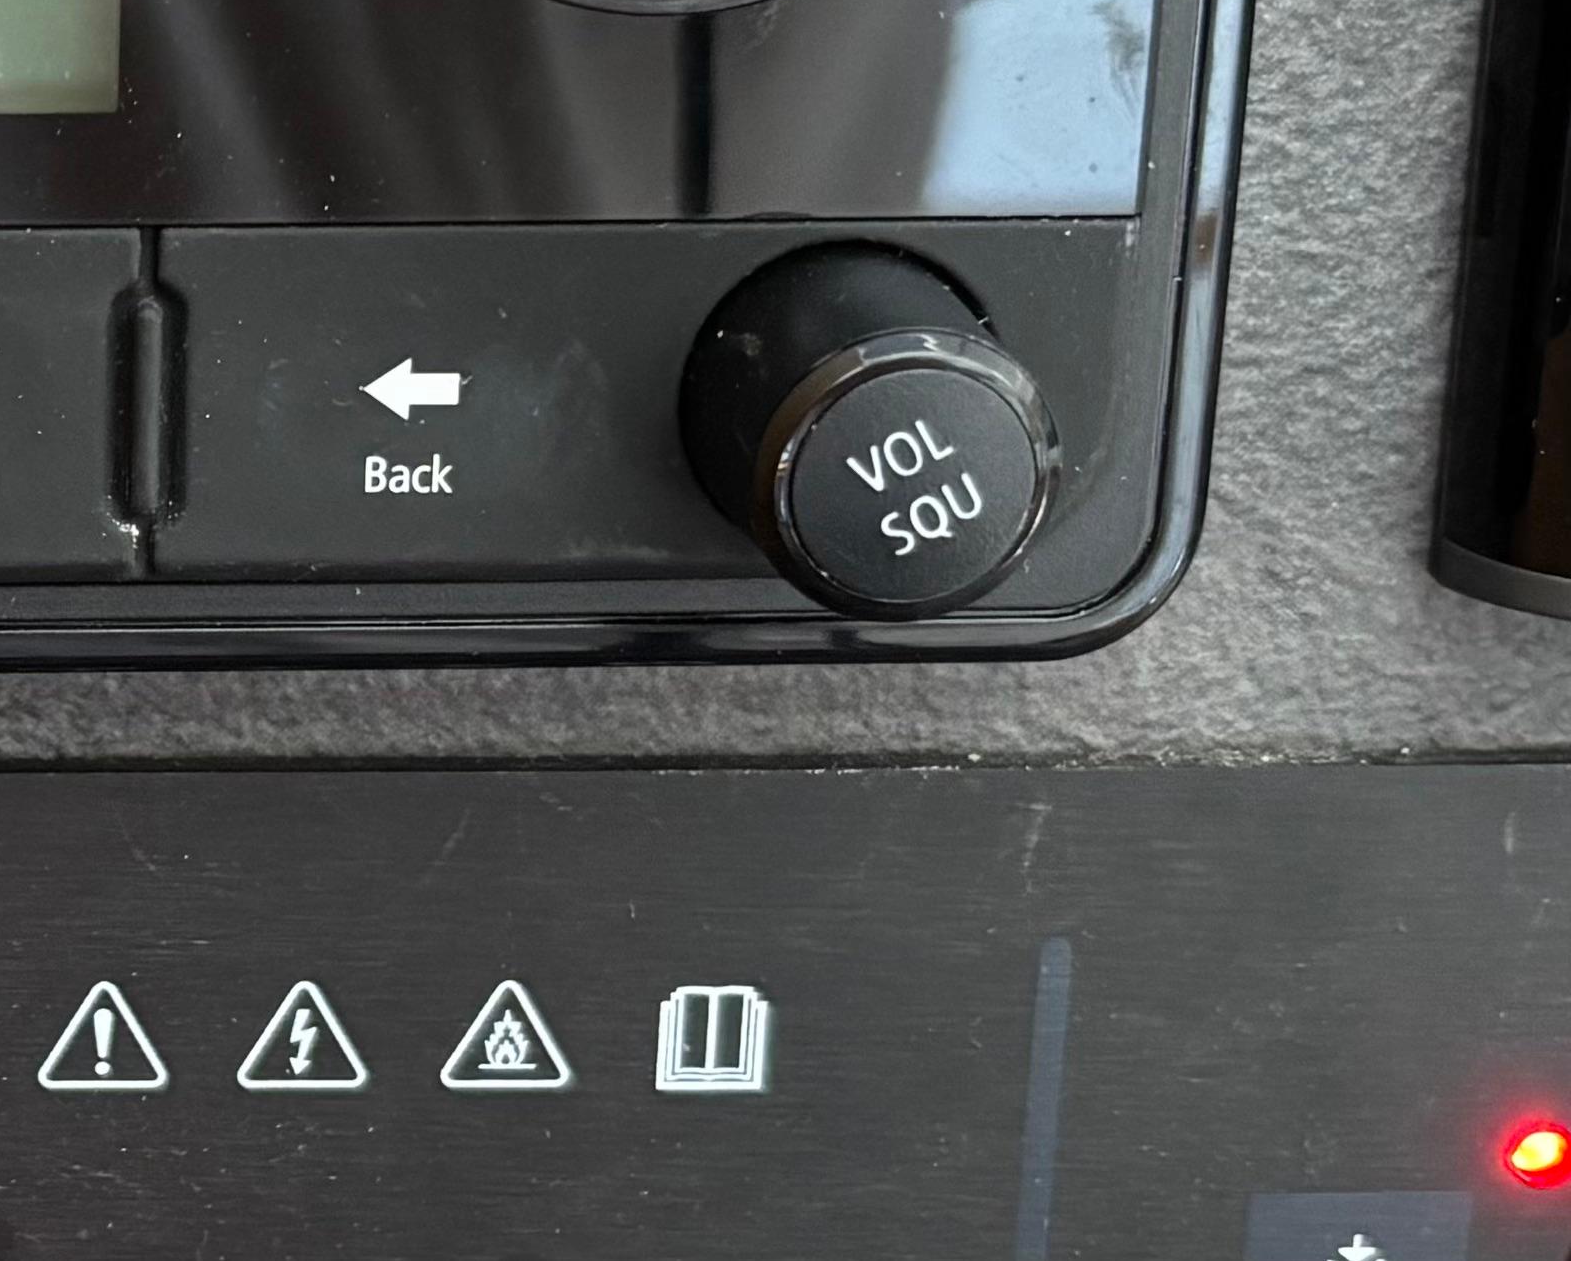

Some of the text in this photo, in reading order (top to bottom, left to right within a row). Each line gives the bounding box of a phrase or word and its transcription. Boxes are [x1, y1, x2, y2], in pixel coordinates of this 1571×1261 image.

[362, 452, 454, 495] Back
[845, 418, 958, 493] VOL
[879, 470, 985, 557] SQU
